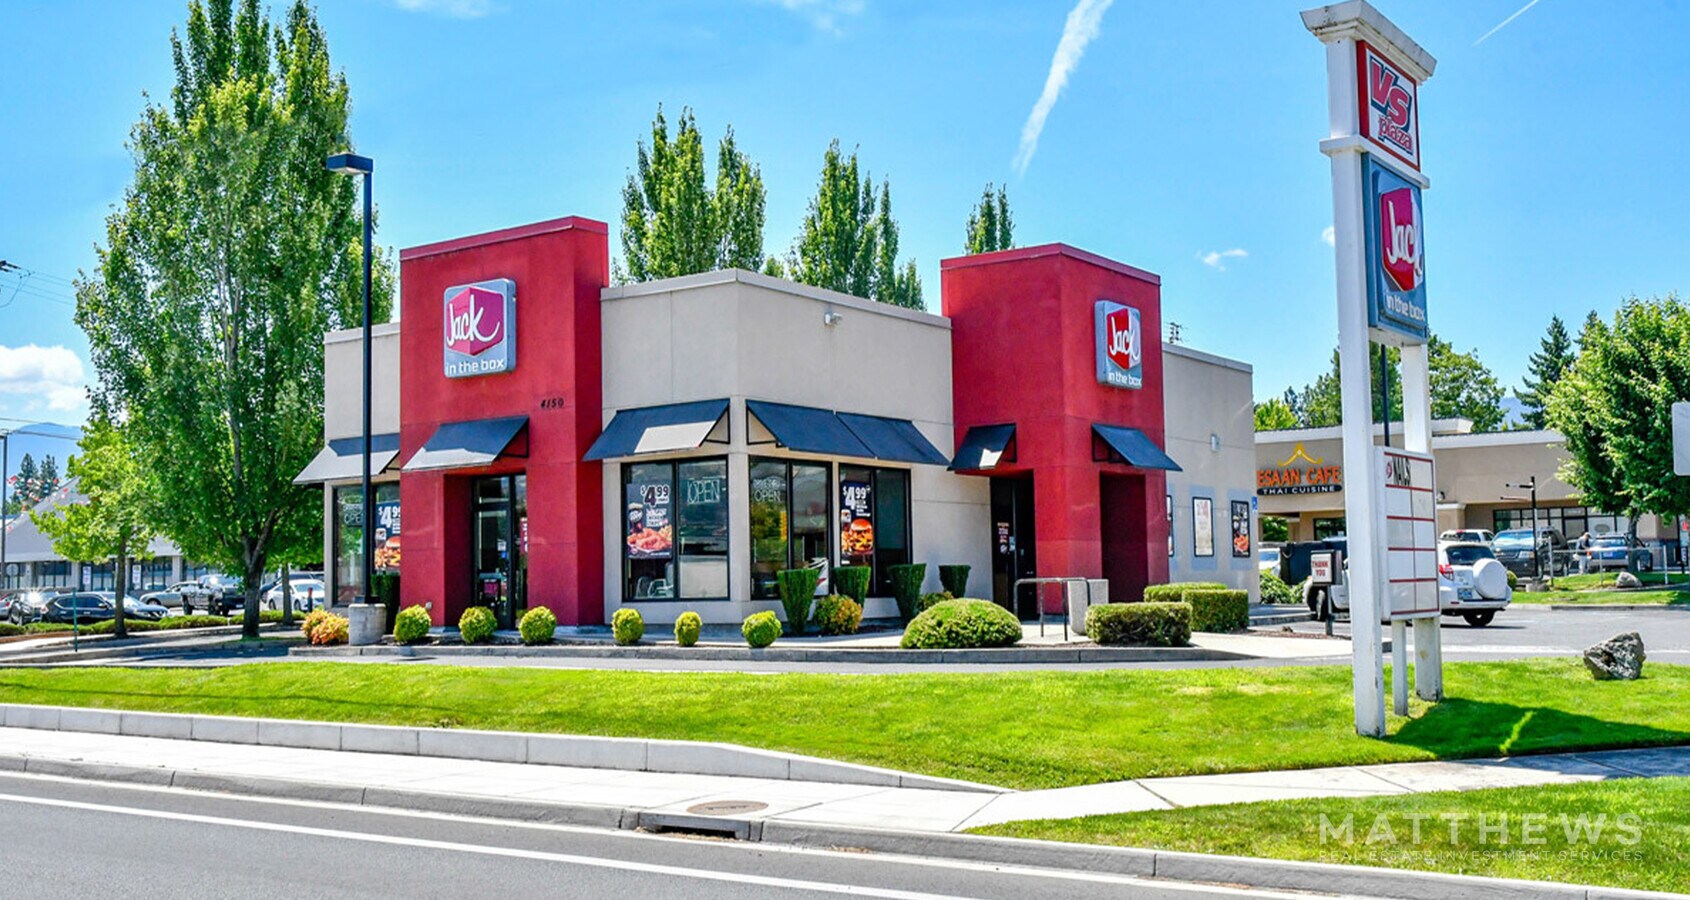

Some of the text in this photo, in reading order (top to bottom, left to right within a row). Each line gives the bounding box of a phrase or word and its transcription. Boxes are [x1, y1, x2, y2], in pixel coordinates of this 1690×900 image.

[1371, 58, 1411, 130] VS
[1379, 115, 1412, 152] plaza
[1386, 200, 1422, 277] Jack
[1386, 292, 1425, 321] in the box
[447, 294, 500, 346] Jack
[1109, 315, 1140, 360] Jack
[446, 358, 504, 375] in the box
[1109, 370, 1142, 386] in the box
[541, 398, 564, 408] 4150
[1256, 466, 1341, 487] ESAAN CAFE
[687, 480, 720, 503] OPEN
[754, 489, 781, 502] OPEN
[1292, 486, 1335, 494] CUISINE
[1312, 560, 1328, 568] THANK
